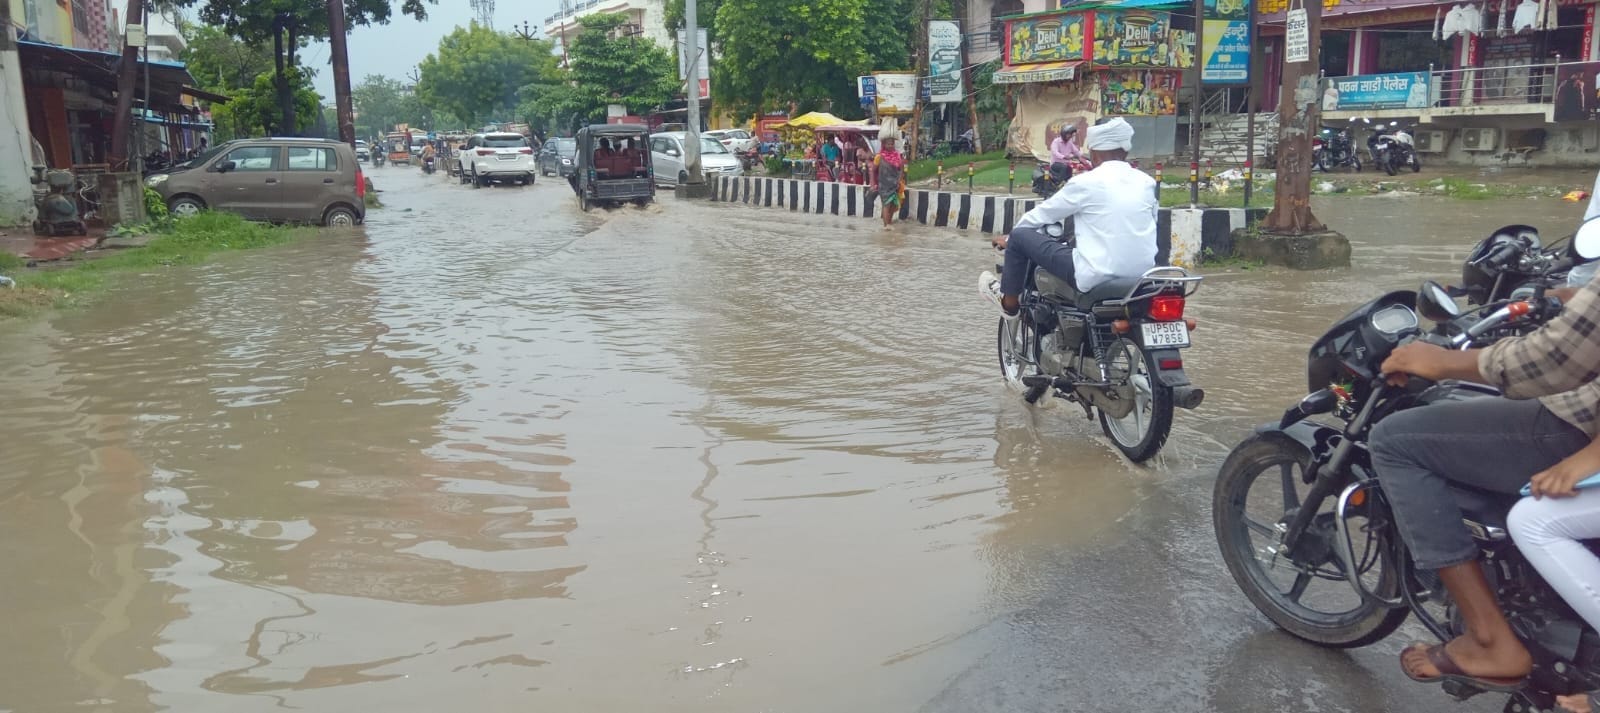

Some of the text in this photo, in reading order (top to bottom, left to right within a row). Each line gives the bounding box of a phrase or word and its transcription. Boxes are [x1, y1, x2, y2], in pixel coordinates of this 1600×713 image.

[1125, 23, 1150, 41] Delhi
[1338, 76, 1409, 94] पवन साड़ी पैलेस
[1150, 323, 1182, 334] UP50C
